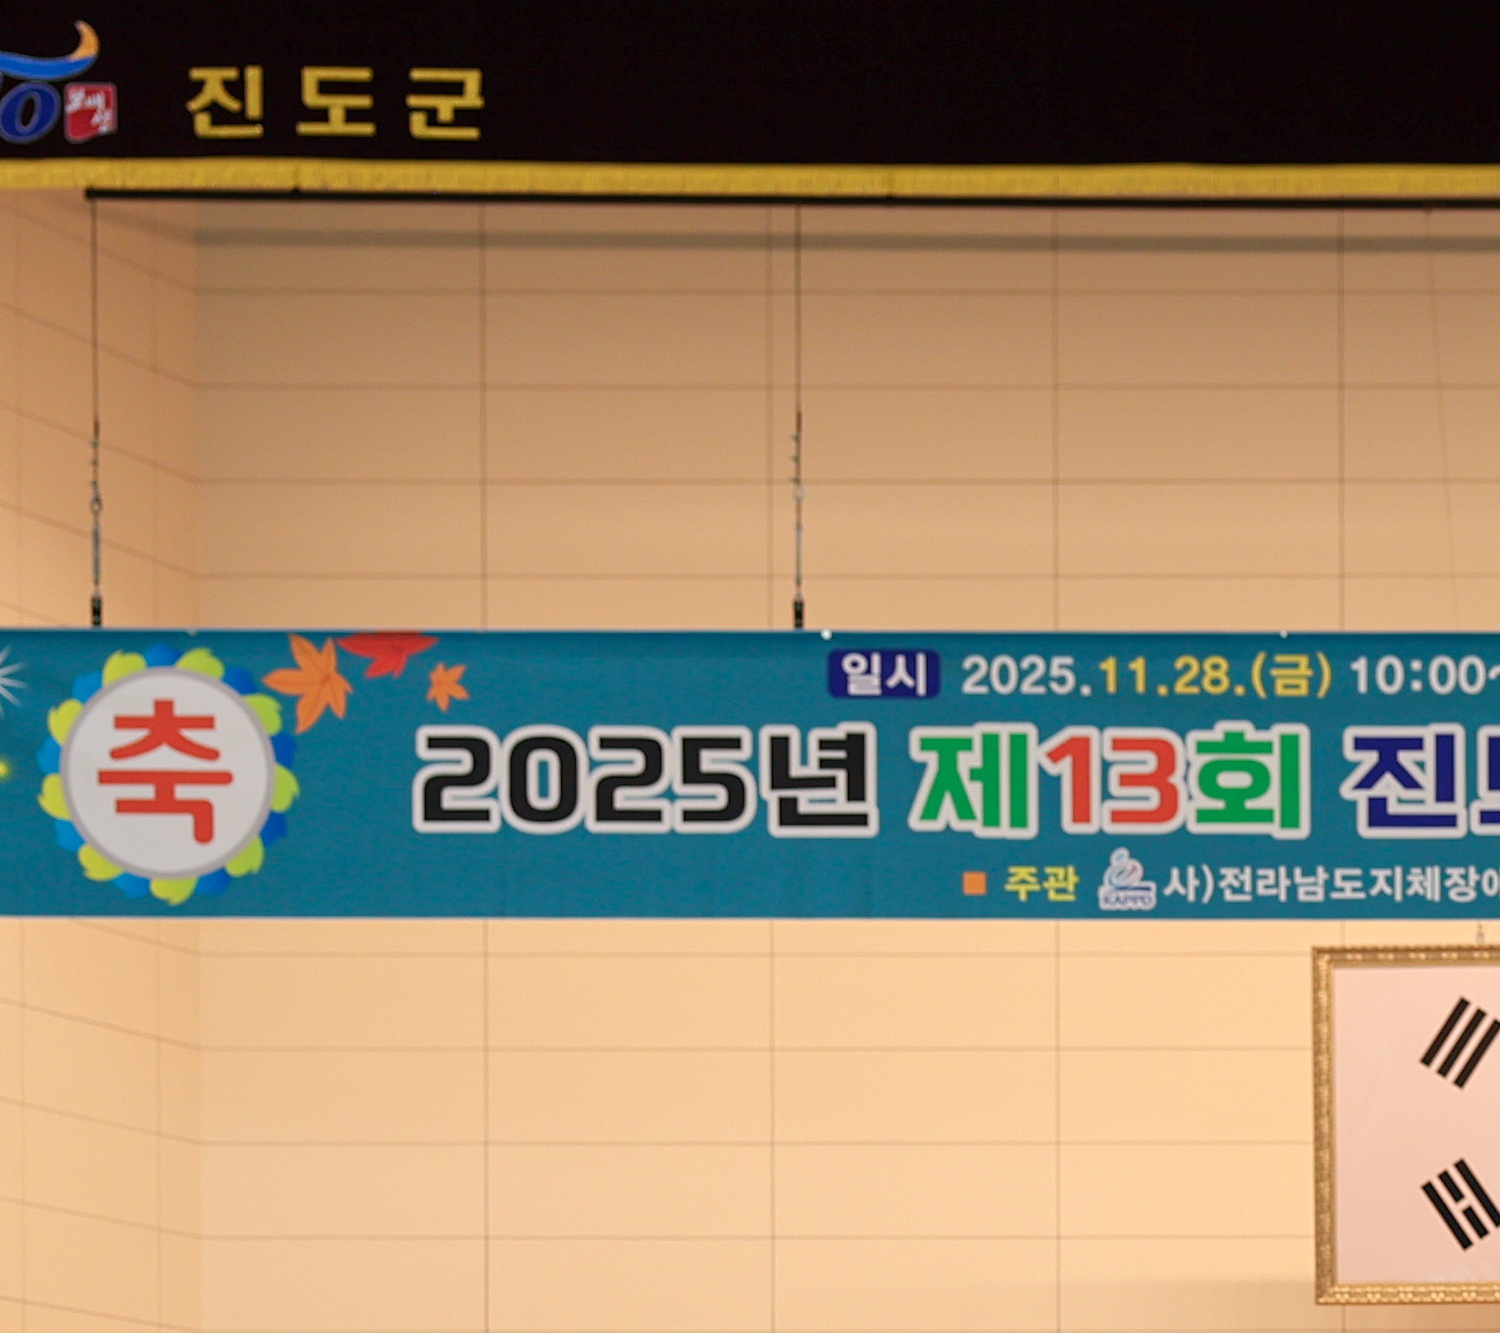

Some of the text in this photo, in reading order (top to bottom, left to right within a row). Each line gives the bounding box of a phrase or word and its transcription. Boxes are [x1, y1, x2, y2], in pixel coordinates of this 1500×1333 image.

[185, 66, 485, 141] 진도군
[841, 652, 928, 697] 일시
[97, 699, 233, 844] 축
[416, 727, 875, 833] 2025년
[915, 725, 1304, 836] 제13회
[1003, 865, 1078, 903] 주관
